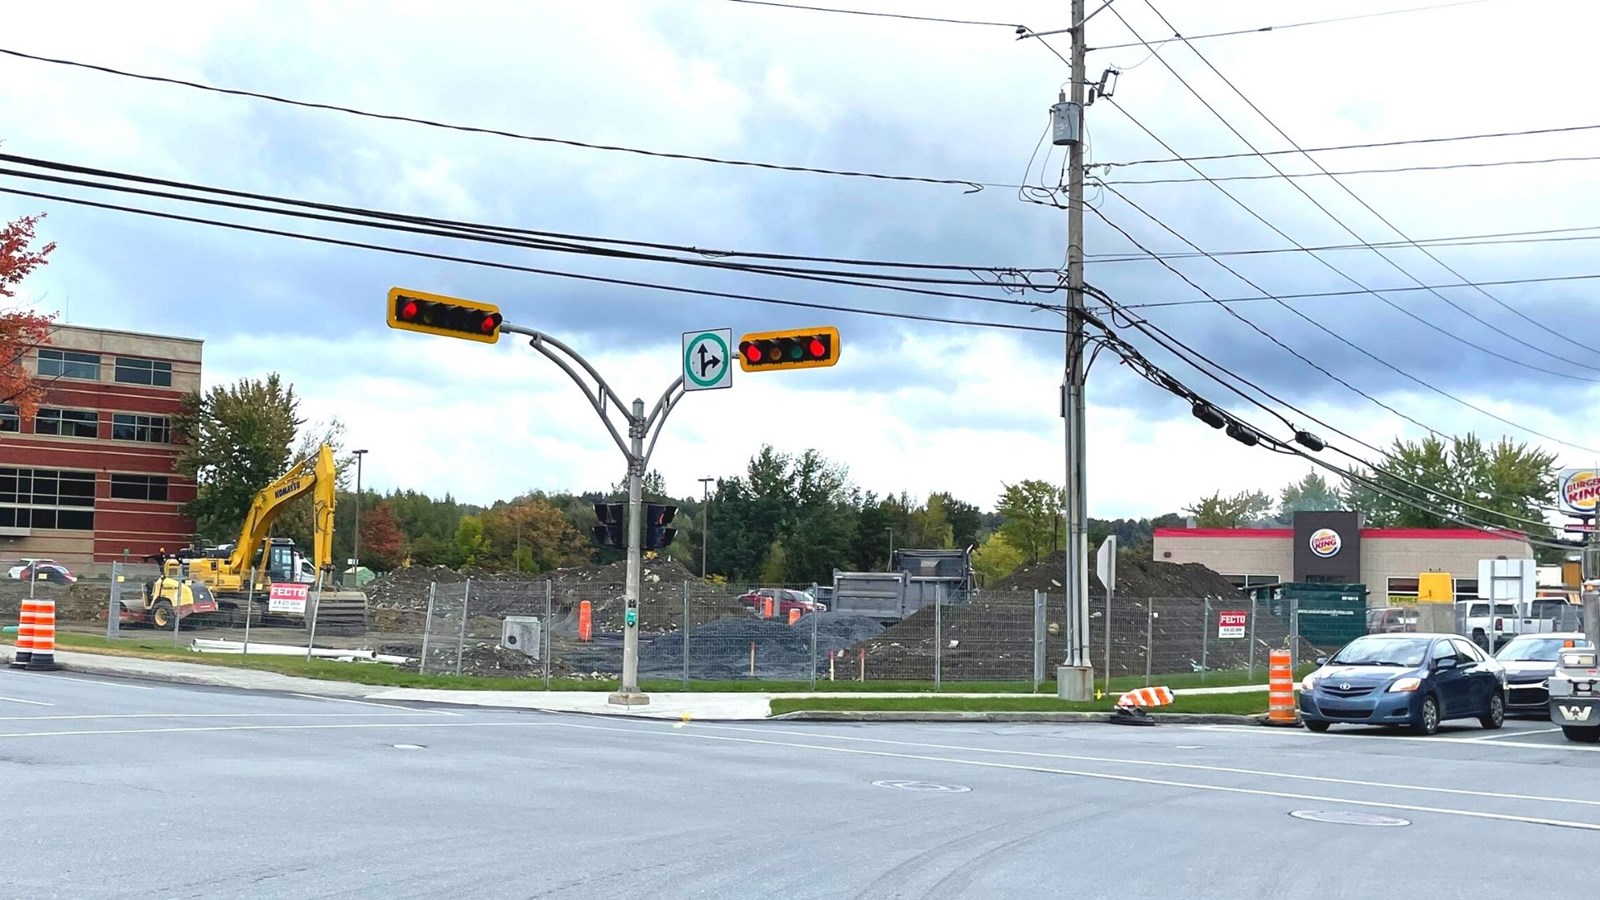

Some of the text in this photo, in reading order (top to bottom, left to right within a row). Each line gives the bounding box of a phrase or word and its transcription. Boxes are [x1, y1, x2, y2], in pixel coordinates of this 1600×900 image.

[274, 481, 301, 499] KOMATSU
[1567, 478, 1600, 493] BURGE
[1315, 540, 1337, 550] KING
[272, 588, 305, 597] FECTO
[1221, 615, 1246, 624] FECTO
